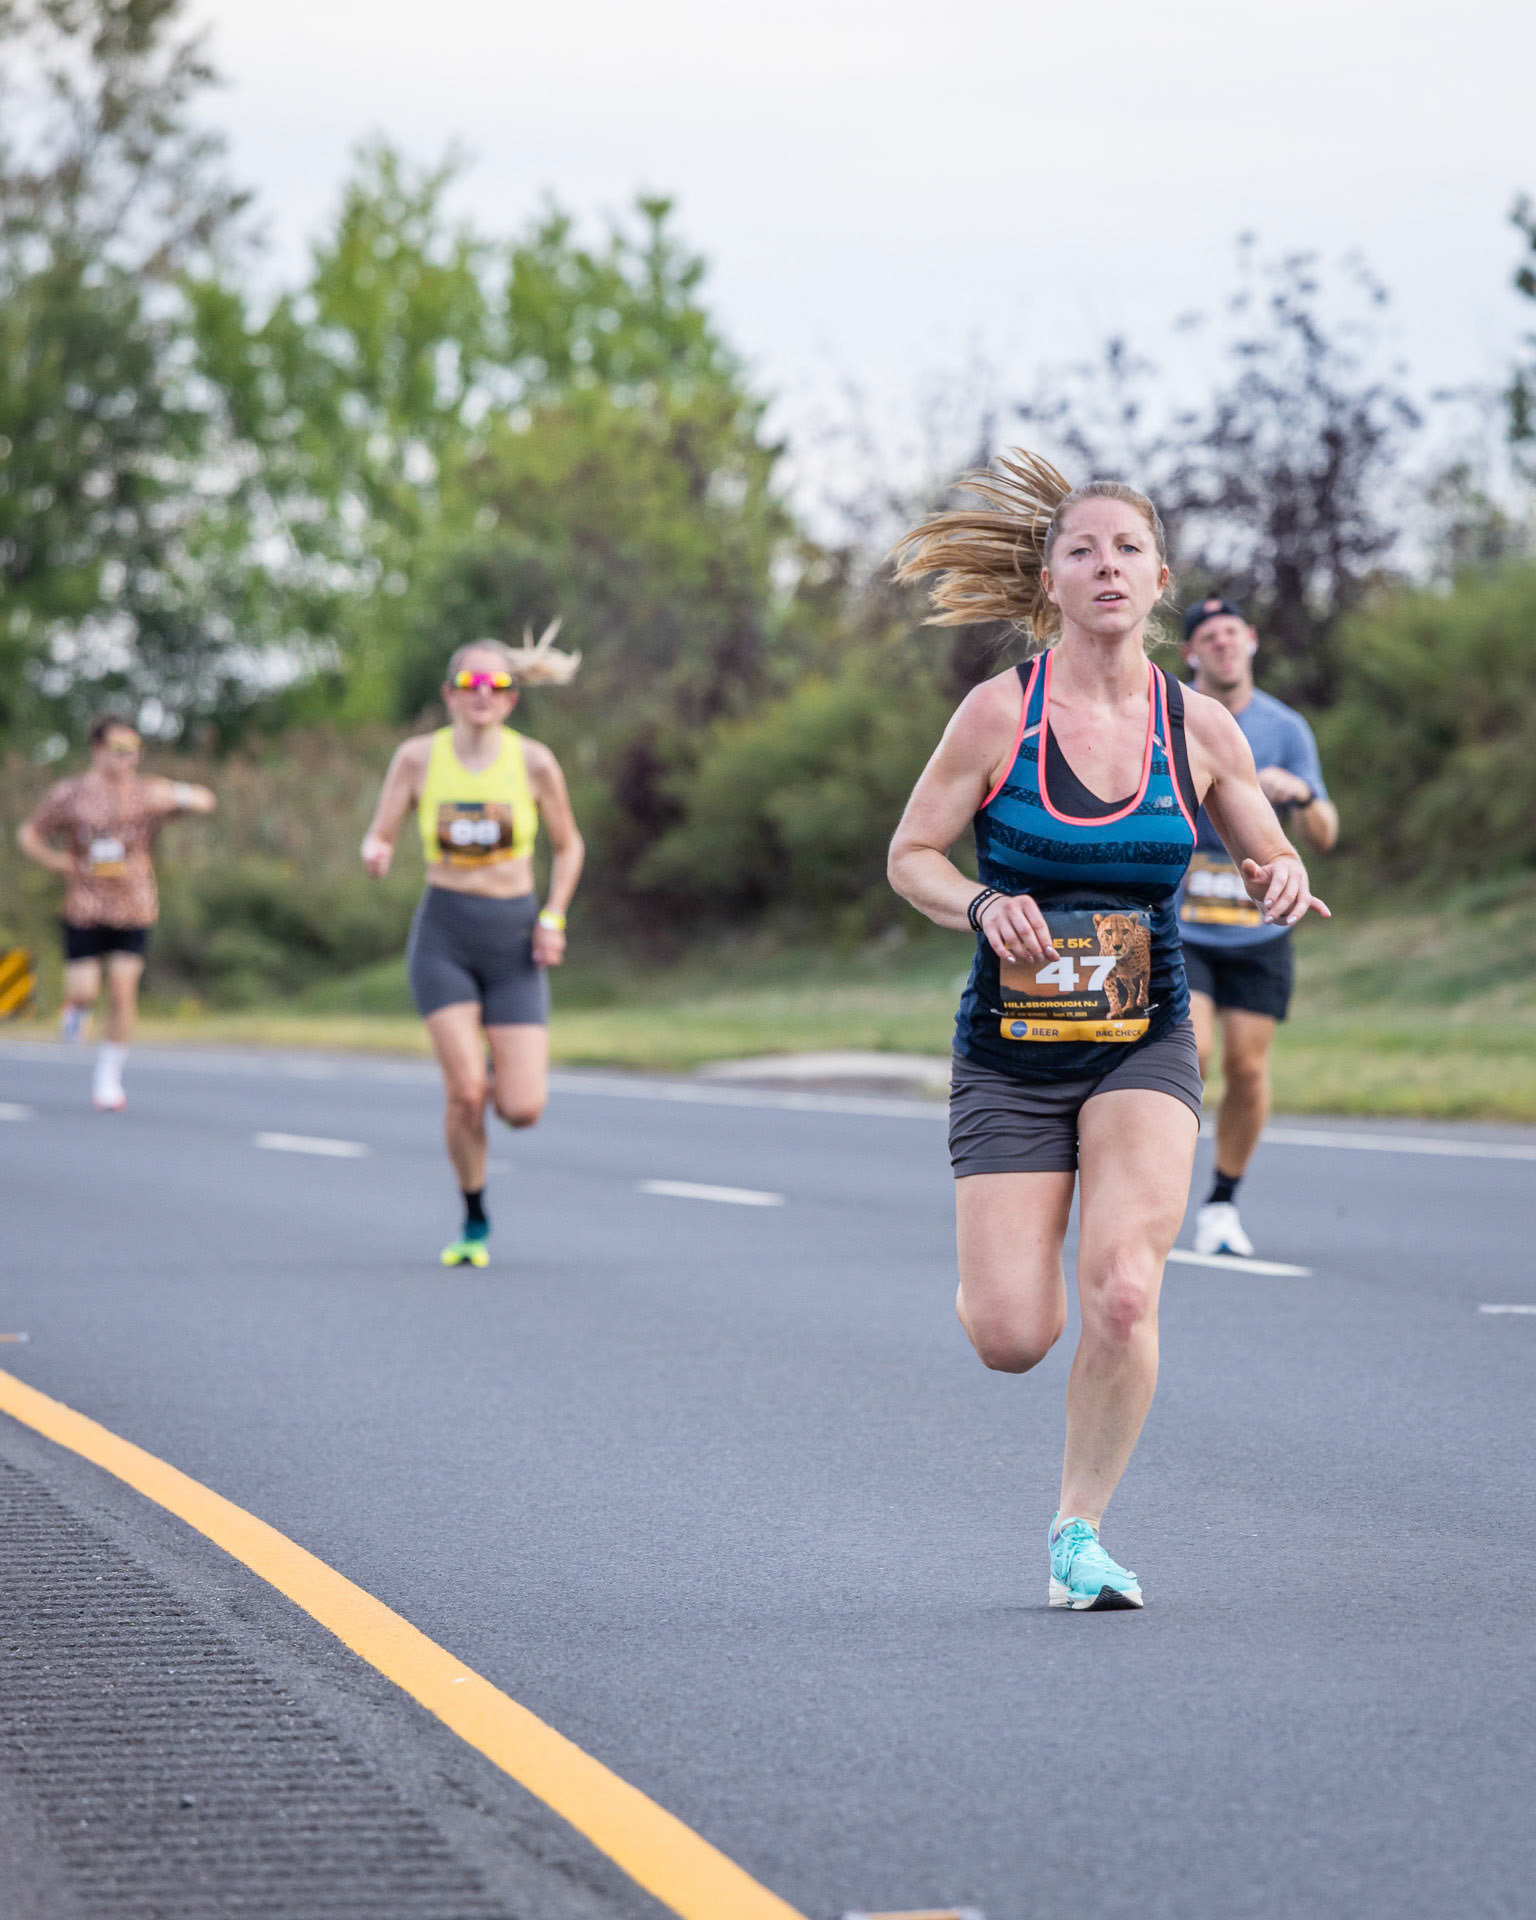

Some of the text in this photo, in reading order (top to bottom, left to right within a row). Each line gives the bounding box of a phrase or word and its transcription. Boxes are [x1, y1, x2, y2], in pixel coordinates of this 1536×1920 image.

[1068, 939, 1092, 948] 5K
[1036, 956, 1116, 991] 47
[1003, 1000, 1082, 1008] HILLSBOROUGH
[1032, 1028, 1059, 1036] BEER
[1115, 1029, 1142, 1037] CHECK
